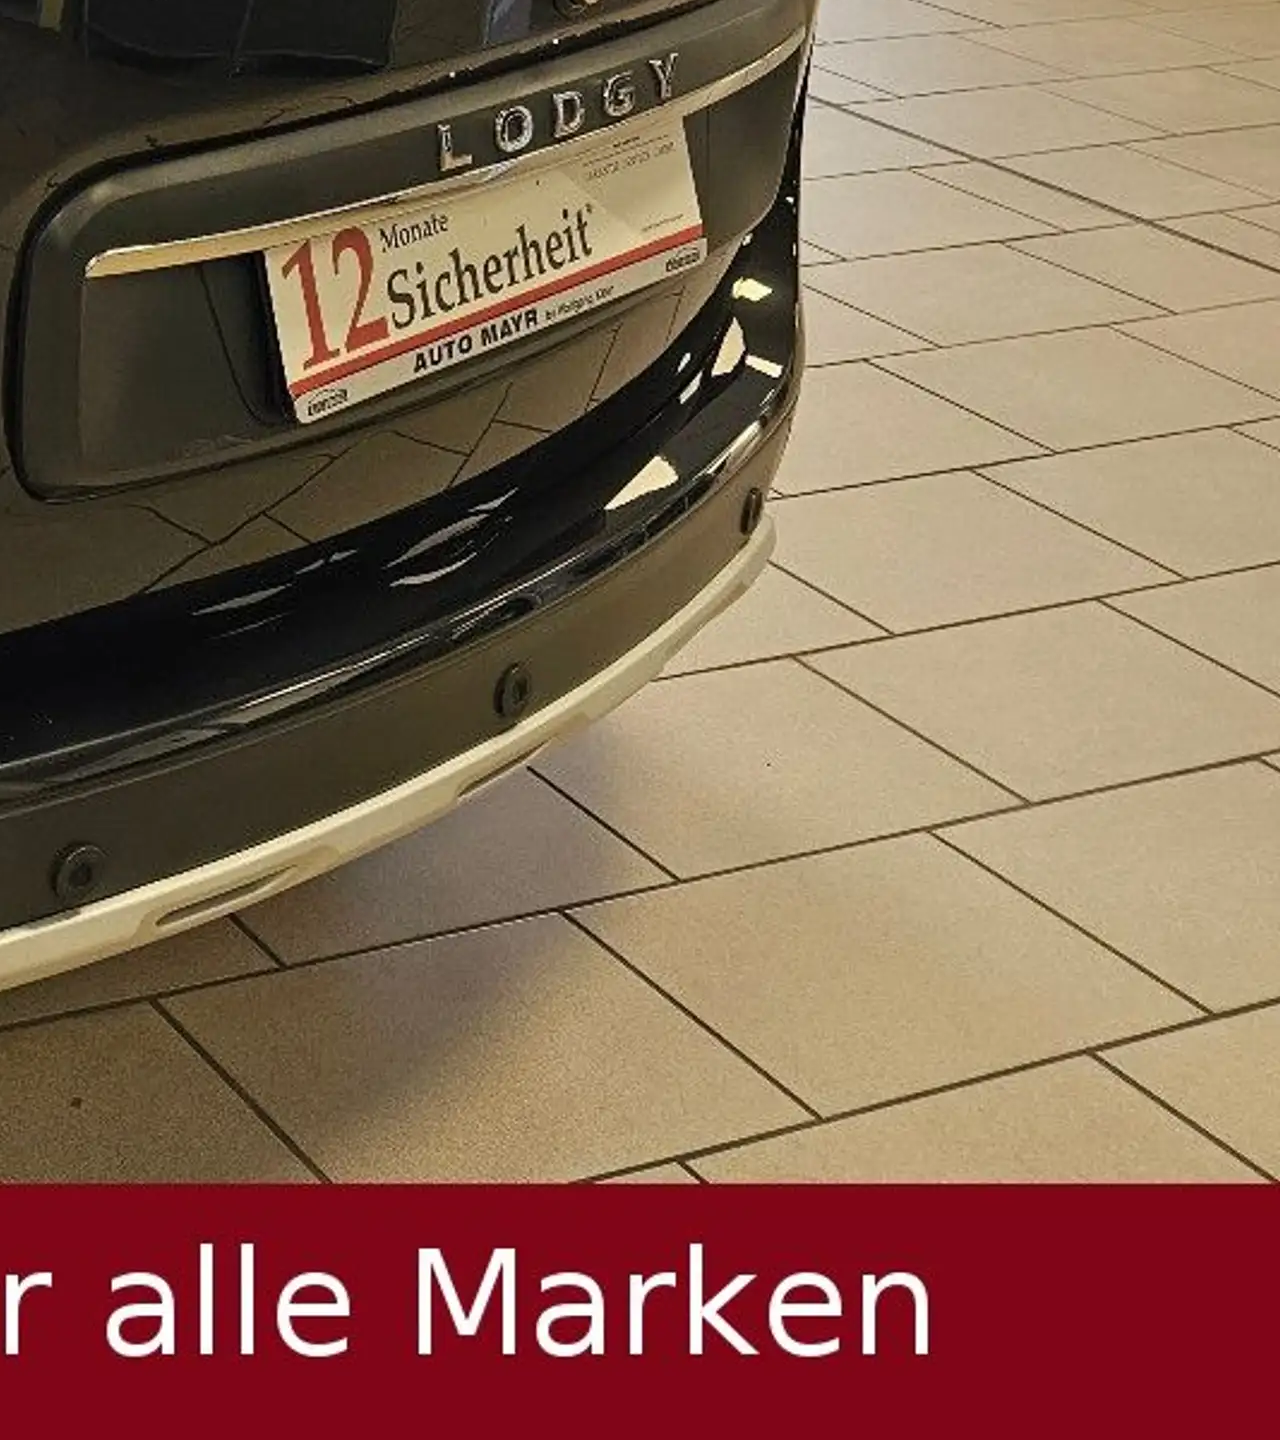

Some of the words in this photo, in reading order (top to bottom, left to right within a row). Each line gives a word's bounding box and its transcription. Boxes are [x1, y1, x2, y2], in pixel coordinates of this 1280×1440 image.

[438, 53, 679, 171] LODGY
[379, 213, 449, 253] Monate
[387, 208, 593, 330] Sicherheit
[282, 226, 390, 371] 12
[413, 335, 473, 373] AUTO
[481, 308, 538, 347] MAYR
